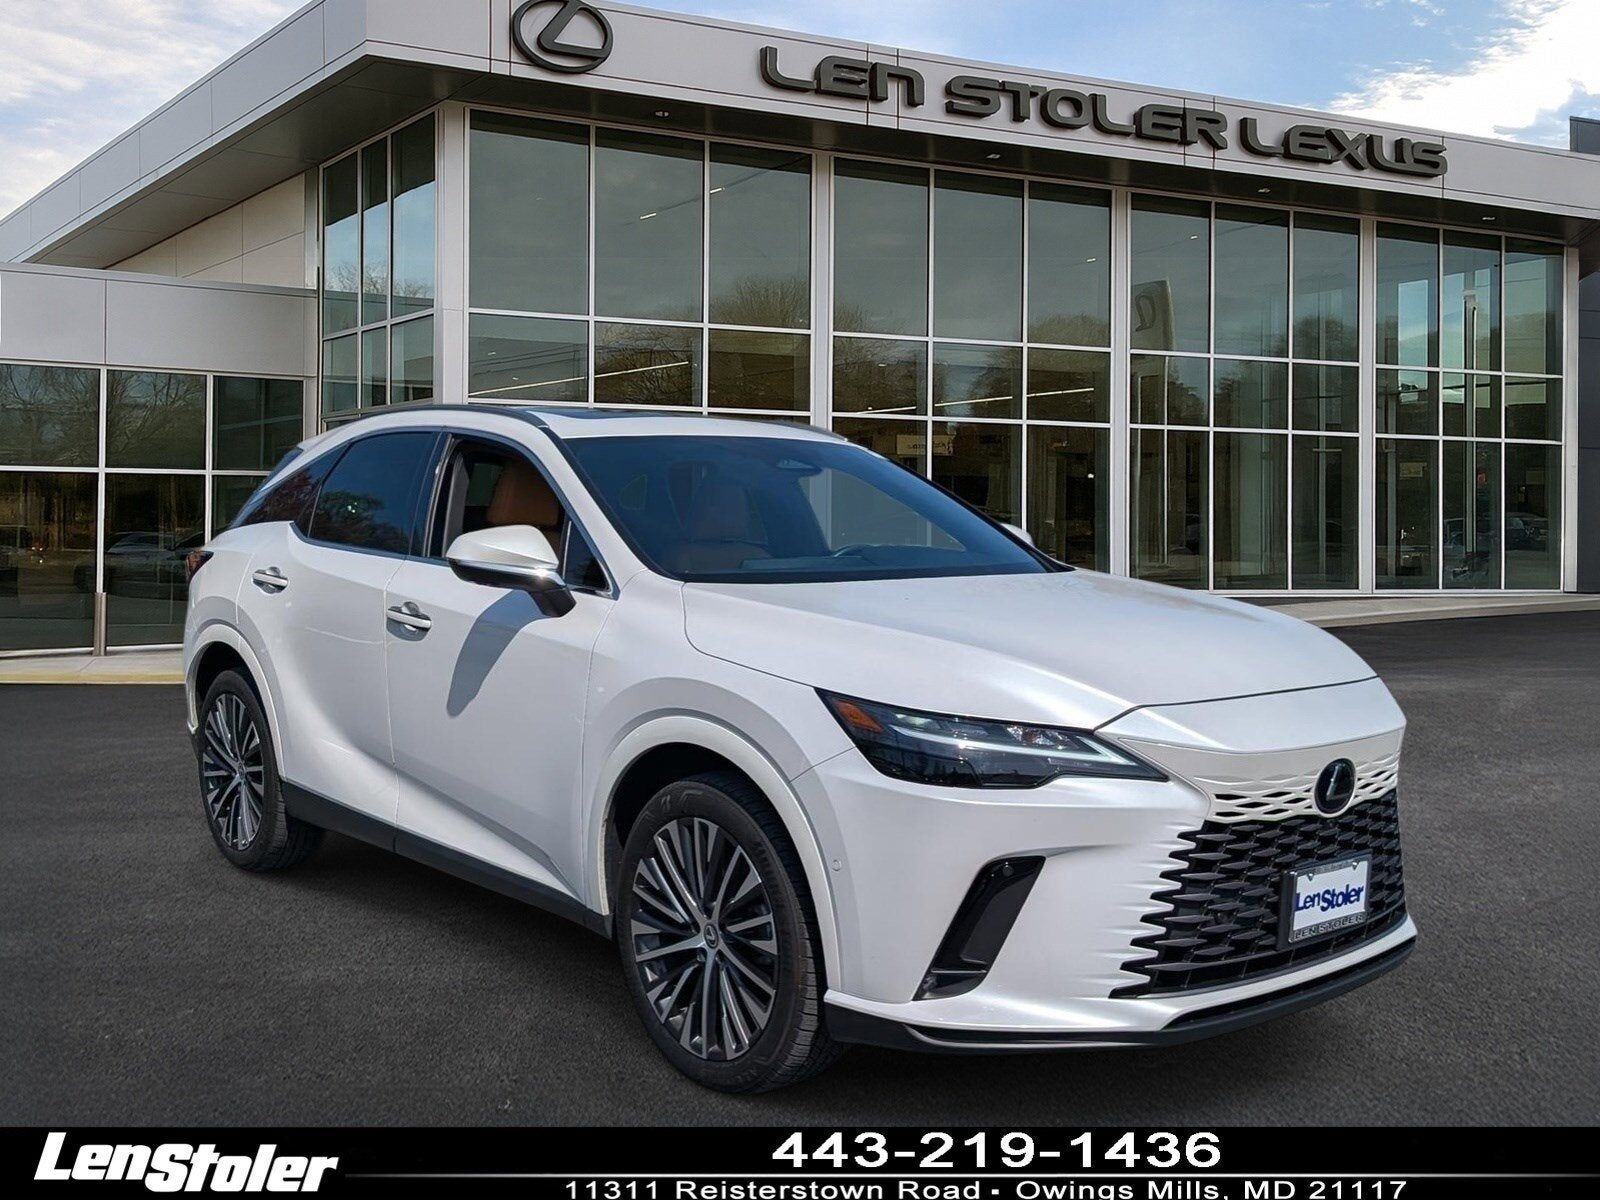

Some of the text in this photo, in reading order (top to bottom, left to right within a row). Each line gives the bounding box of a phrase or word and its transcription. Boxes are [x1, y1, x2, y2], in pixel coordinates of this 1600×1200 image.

[759, 46, 1448, 178] LEN STOLER LEXUS
[1294, 884, 1364, 912] LenStoler
